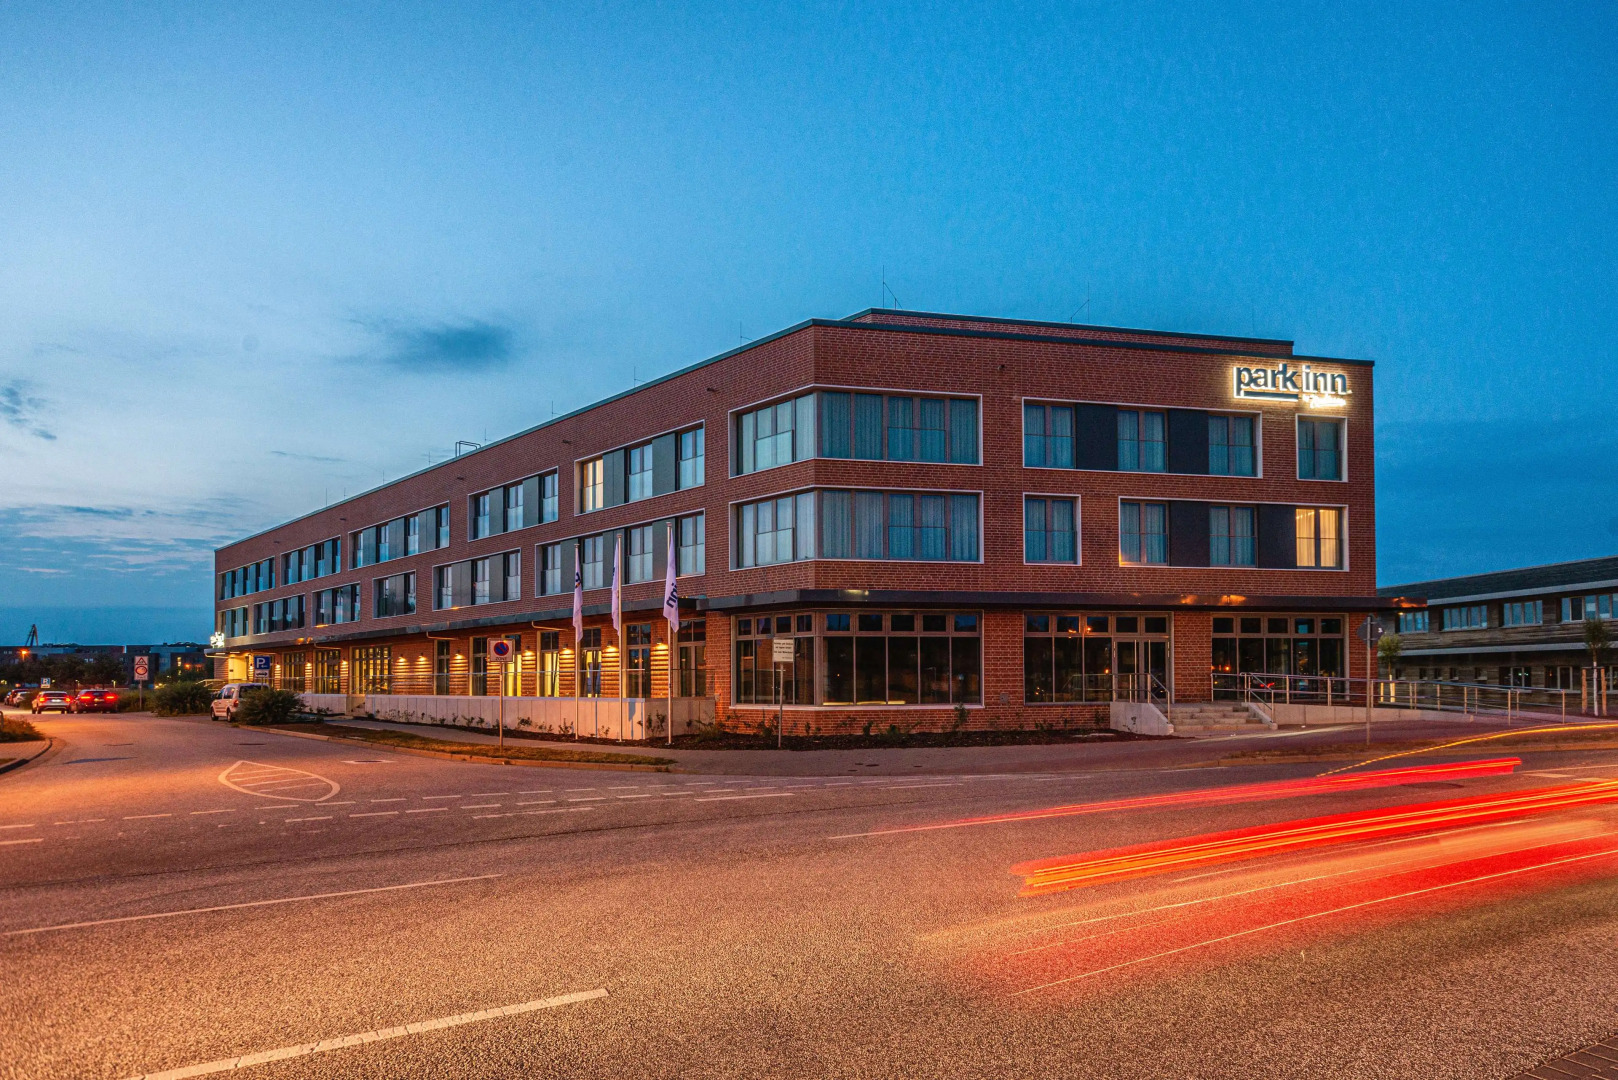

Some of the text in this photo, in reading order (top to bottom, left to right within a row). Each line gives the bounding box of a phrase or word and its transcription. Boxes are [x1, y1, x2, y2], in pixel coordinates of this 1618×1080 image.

[1235, 363, 1347, 399] park inn
[256, 657, 266, 668] P
